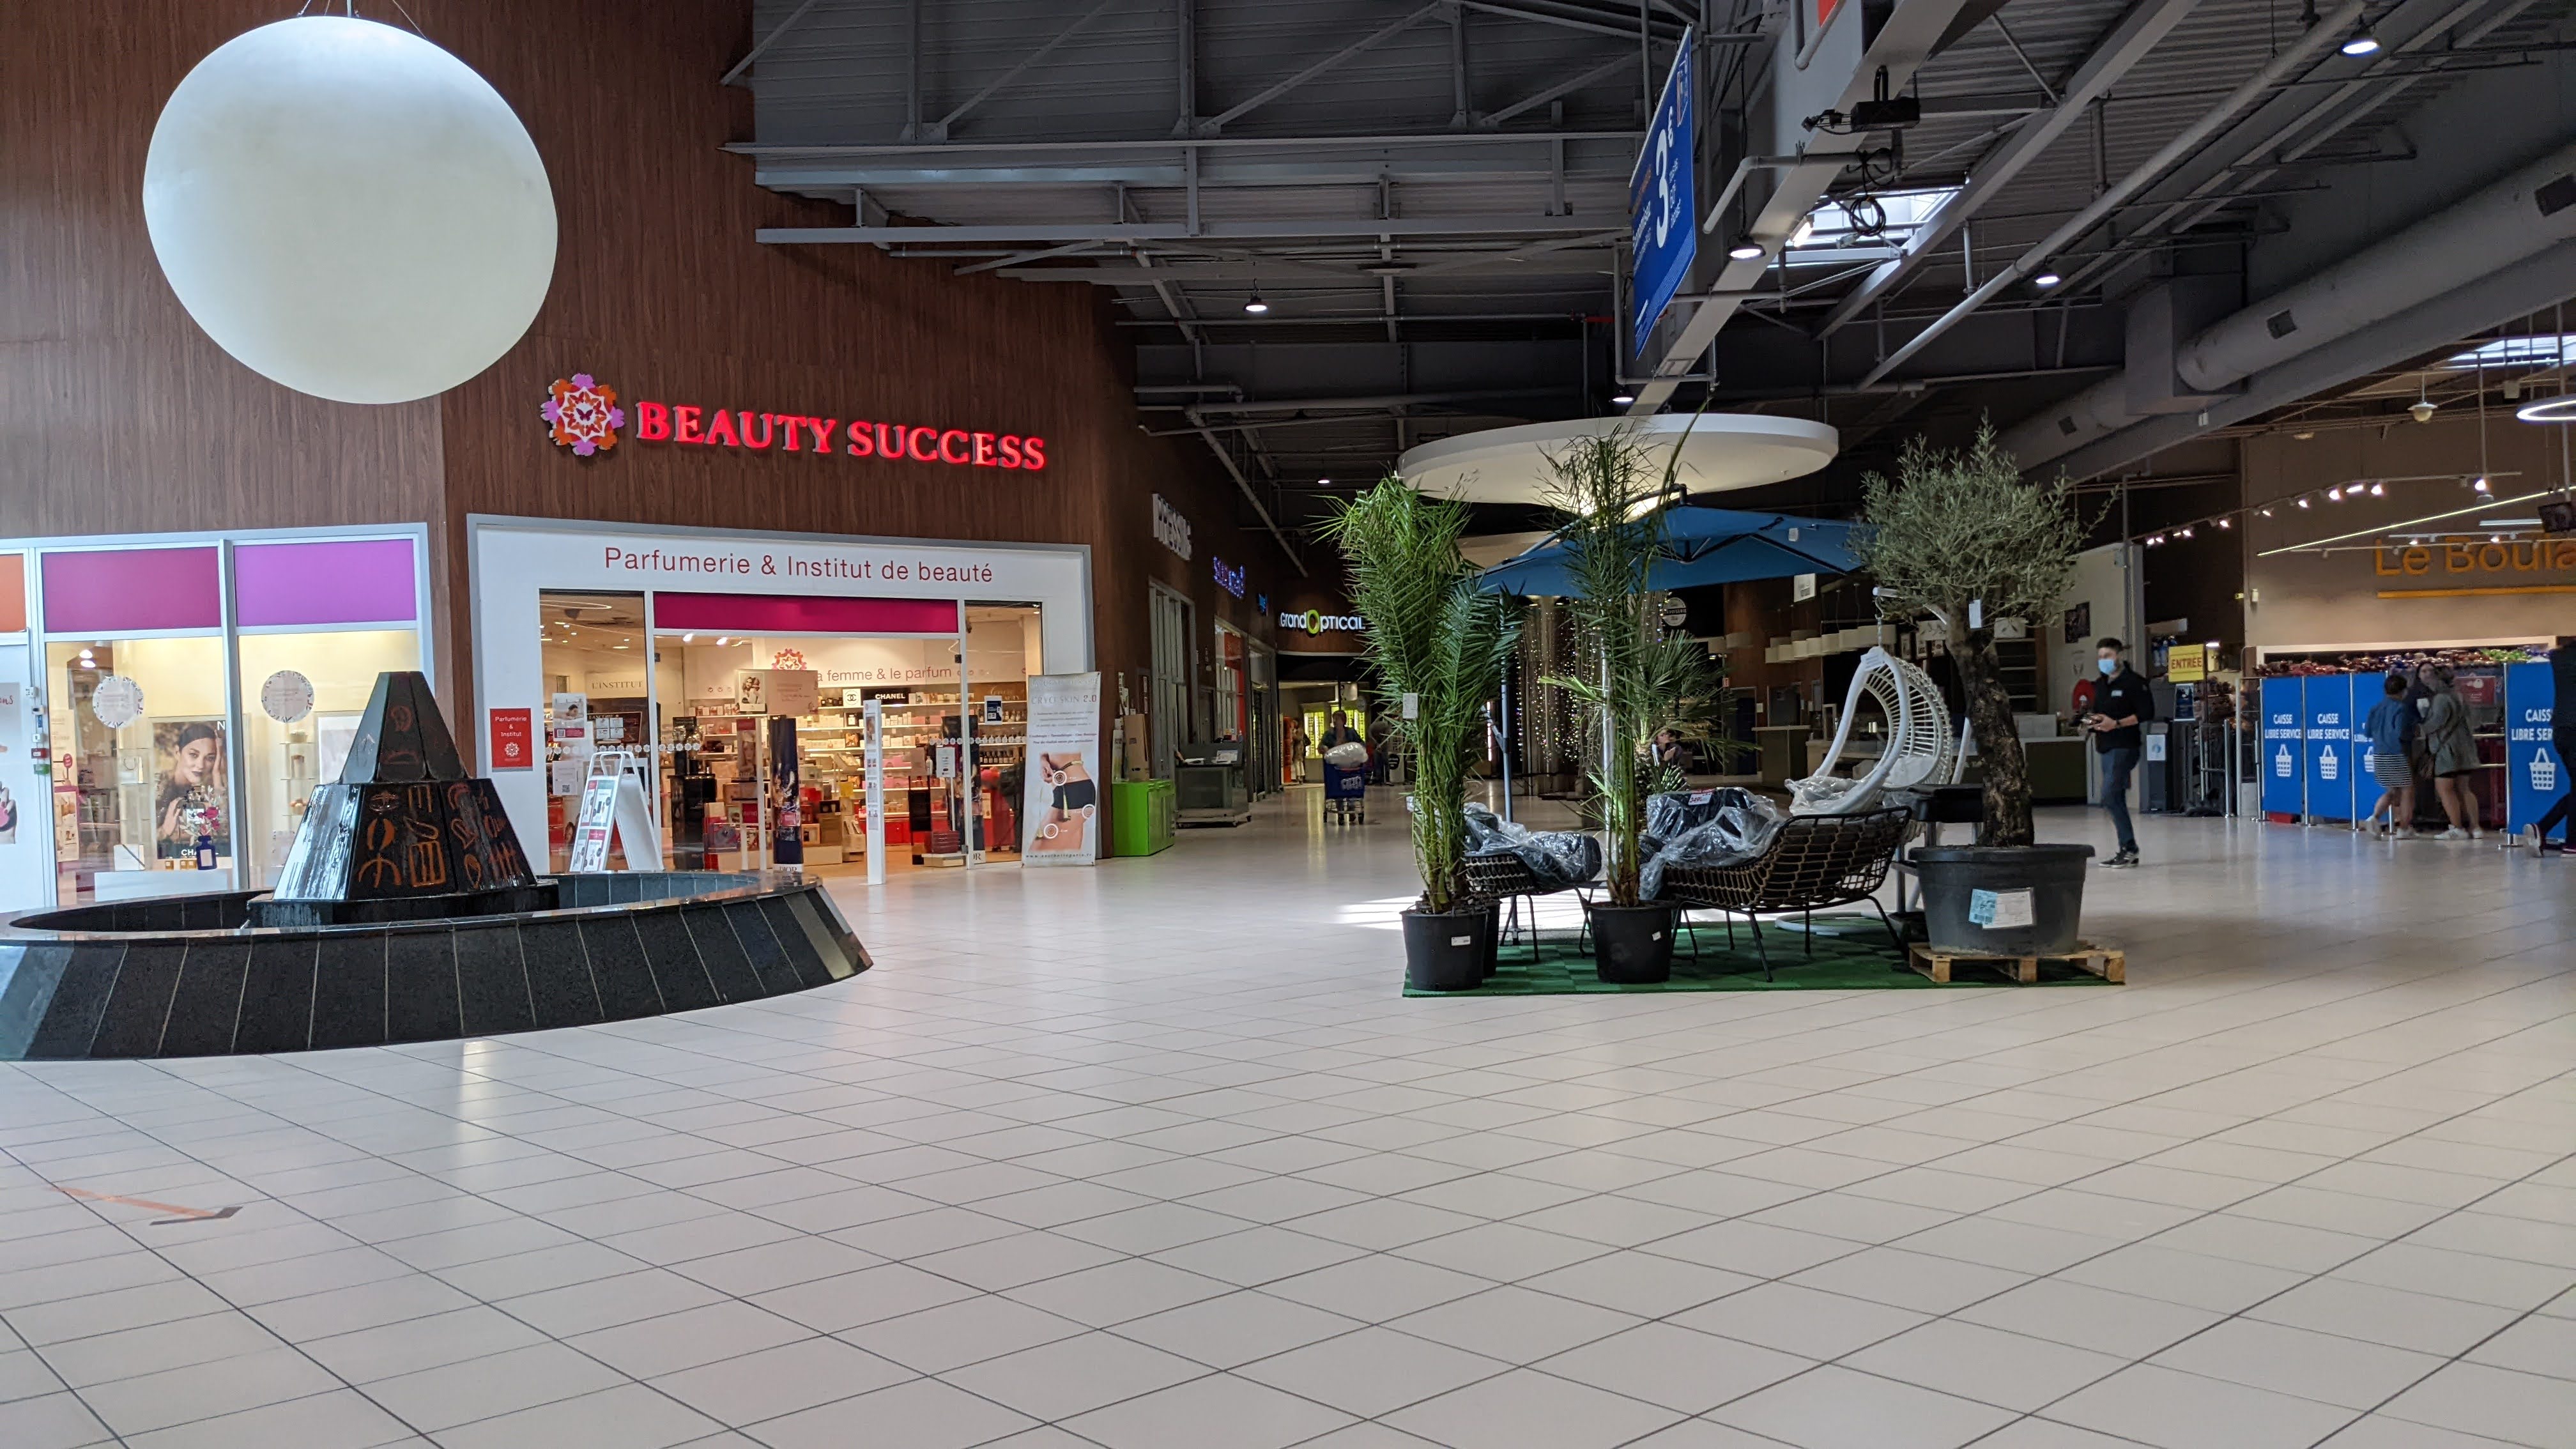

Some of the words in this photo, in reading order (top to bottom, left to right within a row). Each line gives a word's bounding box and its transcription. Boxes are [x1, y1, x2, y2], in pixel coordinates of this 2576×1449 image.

[636, 401, 837, 453] BEAUTY
[847, 420, 1046, 470] SUCCESS
[2375, 538, 2432, 576] Le
[605, 547, 750, 574] Parfumerie
[760, 555, 777, 575] &
[788, 555, 871, 579] Institut
[881, 560, 908, 580] de
[919, 561, 992, 582] beauté
[827, 670, 872, 682] femme
[877, 668, 886, 680] &
[891, 668, 901, 679] le
[905, 666, 951, 682] parfum
[1083, 694, 1097, 703] 2.0
[2273, 714, 2293, 724] CAISSE
[2317, 713, 2338, 724] CAISSE
[2525, 709, 2553, 722] CAISS
[2265, 729, 2279, 739] LIBRE
[2280, 728, 2302, 739] SERVICE
[2307, 729, 2323, 739] LIBRE
[2324, 728, 2350, 739] SERVICE
[2511, 728, 2534, 740] LIBRE
